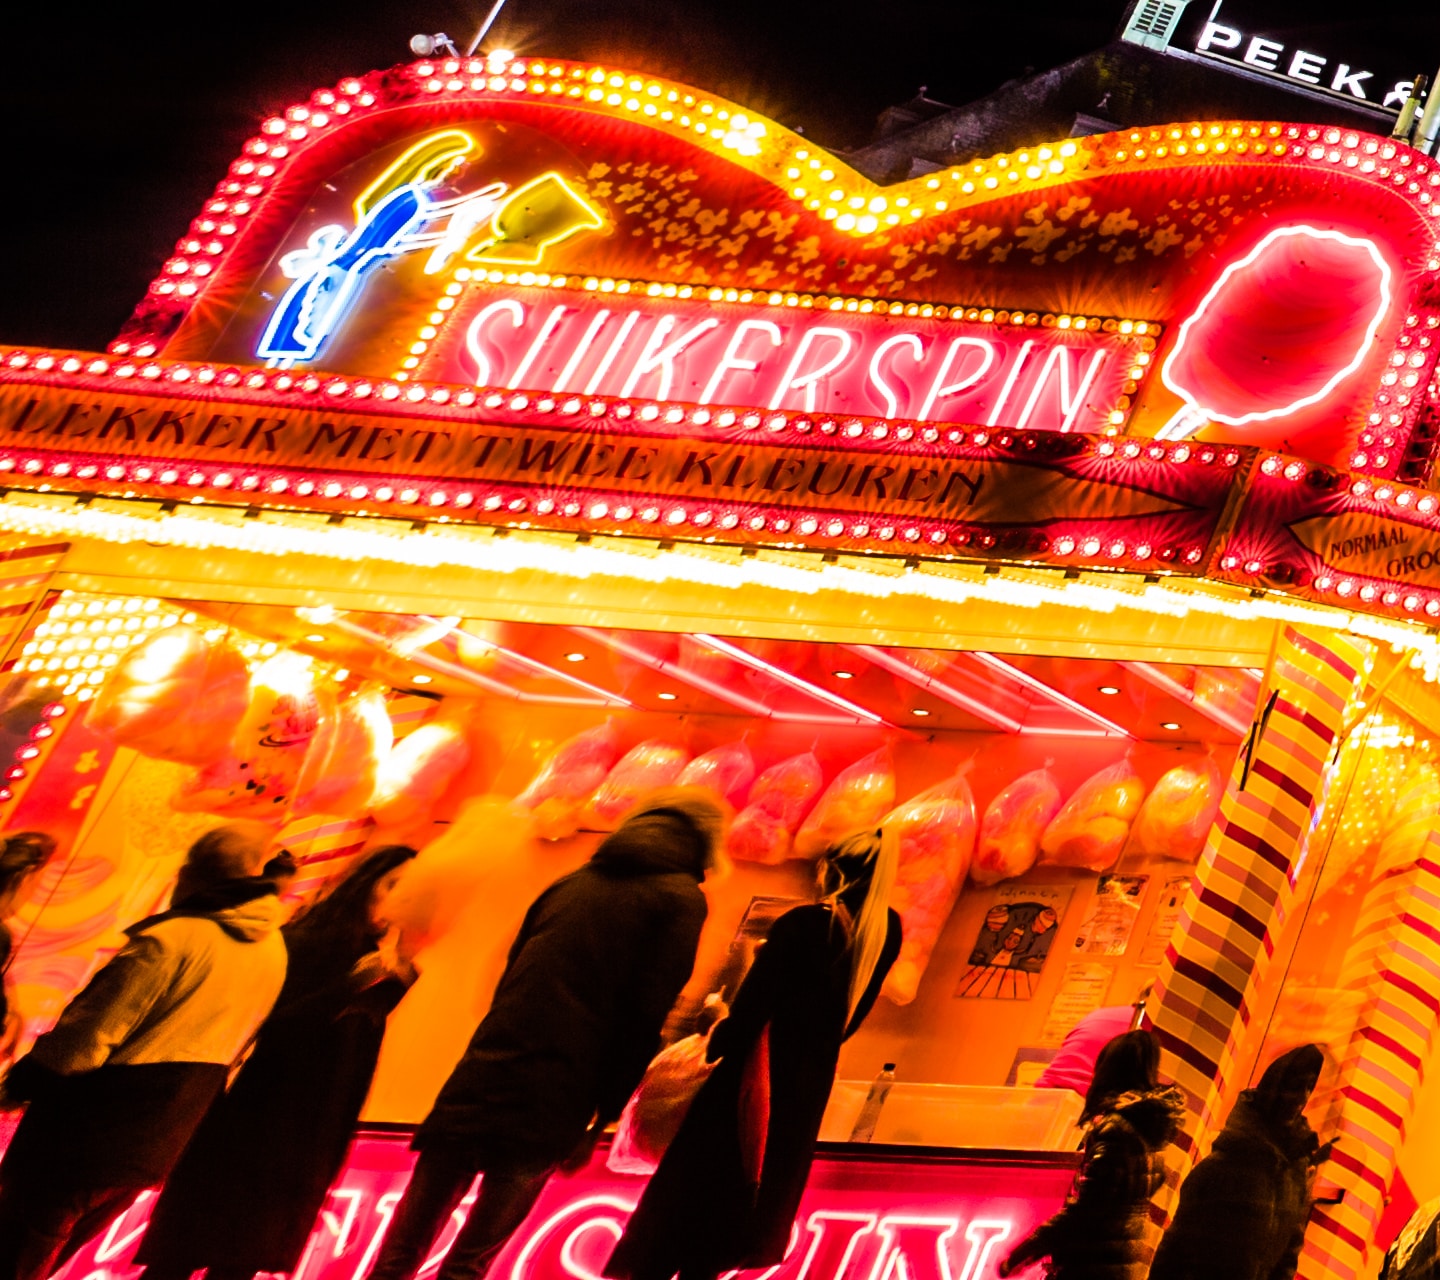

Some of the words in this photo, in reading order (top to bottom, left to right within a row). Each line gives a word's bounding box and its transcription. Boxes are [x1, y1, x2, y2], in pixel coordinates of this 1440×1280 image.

[1196, 22, 1375, 100] PEEK
[464, 297, 1107, 431] SUIKERSPIN
[10, 397, 289, 454] LEKKER
[304, 422, 452, 464] MET
[472, 433, 659, 482] TWEE
[674, 449, 986, 507] KLEUREN
[1330, 527, 1409, 560] NORMAAL
